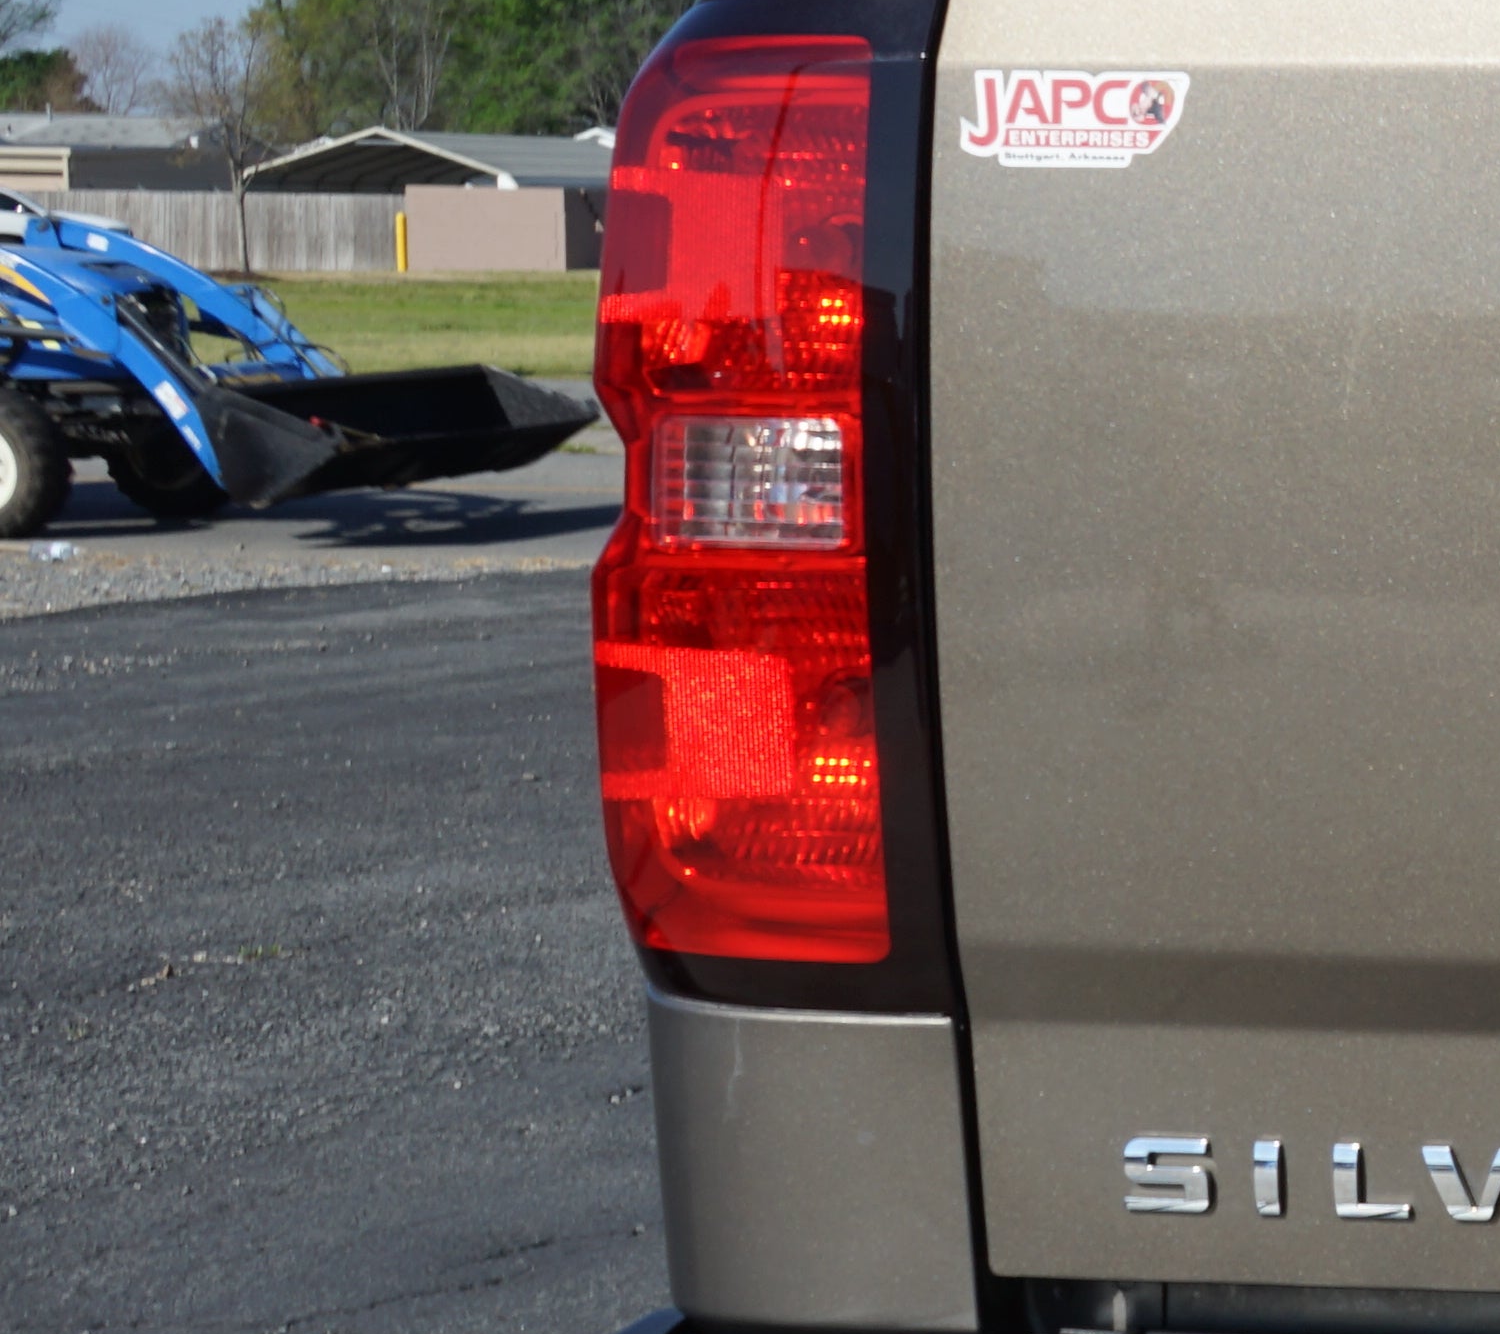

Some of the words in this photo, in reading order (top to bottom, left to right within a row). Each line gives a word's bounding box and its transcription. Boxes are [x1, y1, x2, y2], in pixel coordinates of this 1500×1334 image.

[968, 78, 1175, 147] JAPCO
[1008, 130, 1150, 148] ENTERPRISES
[1069, 151, 1126, 161] Arkansas
